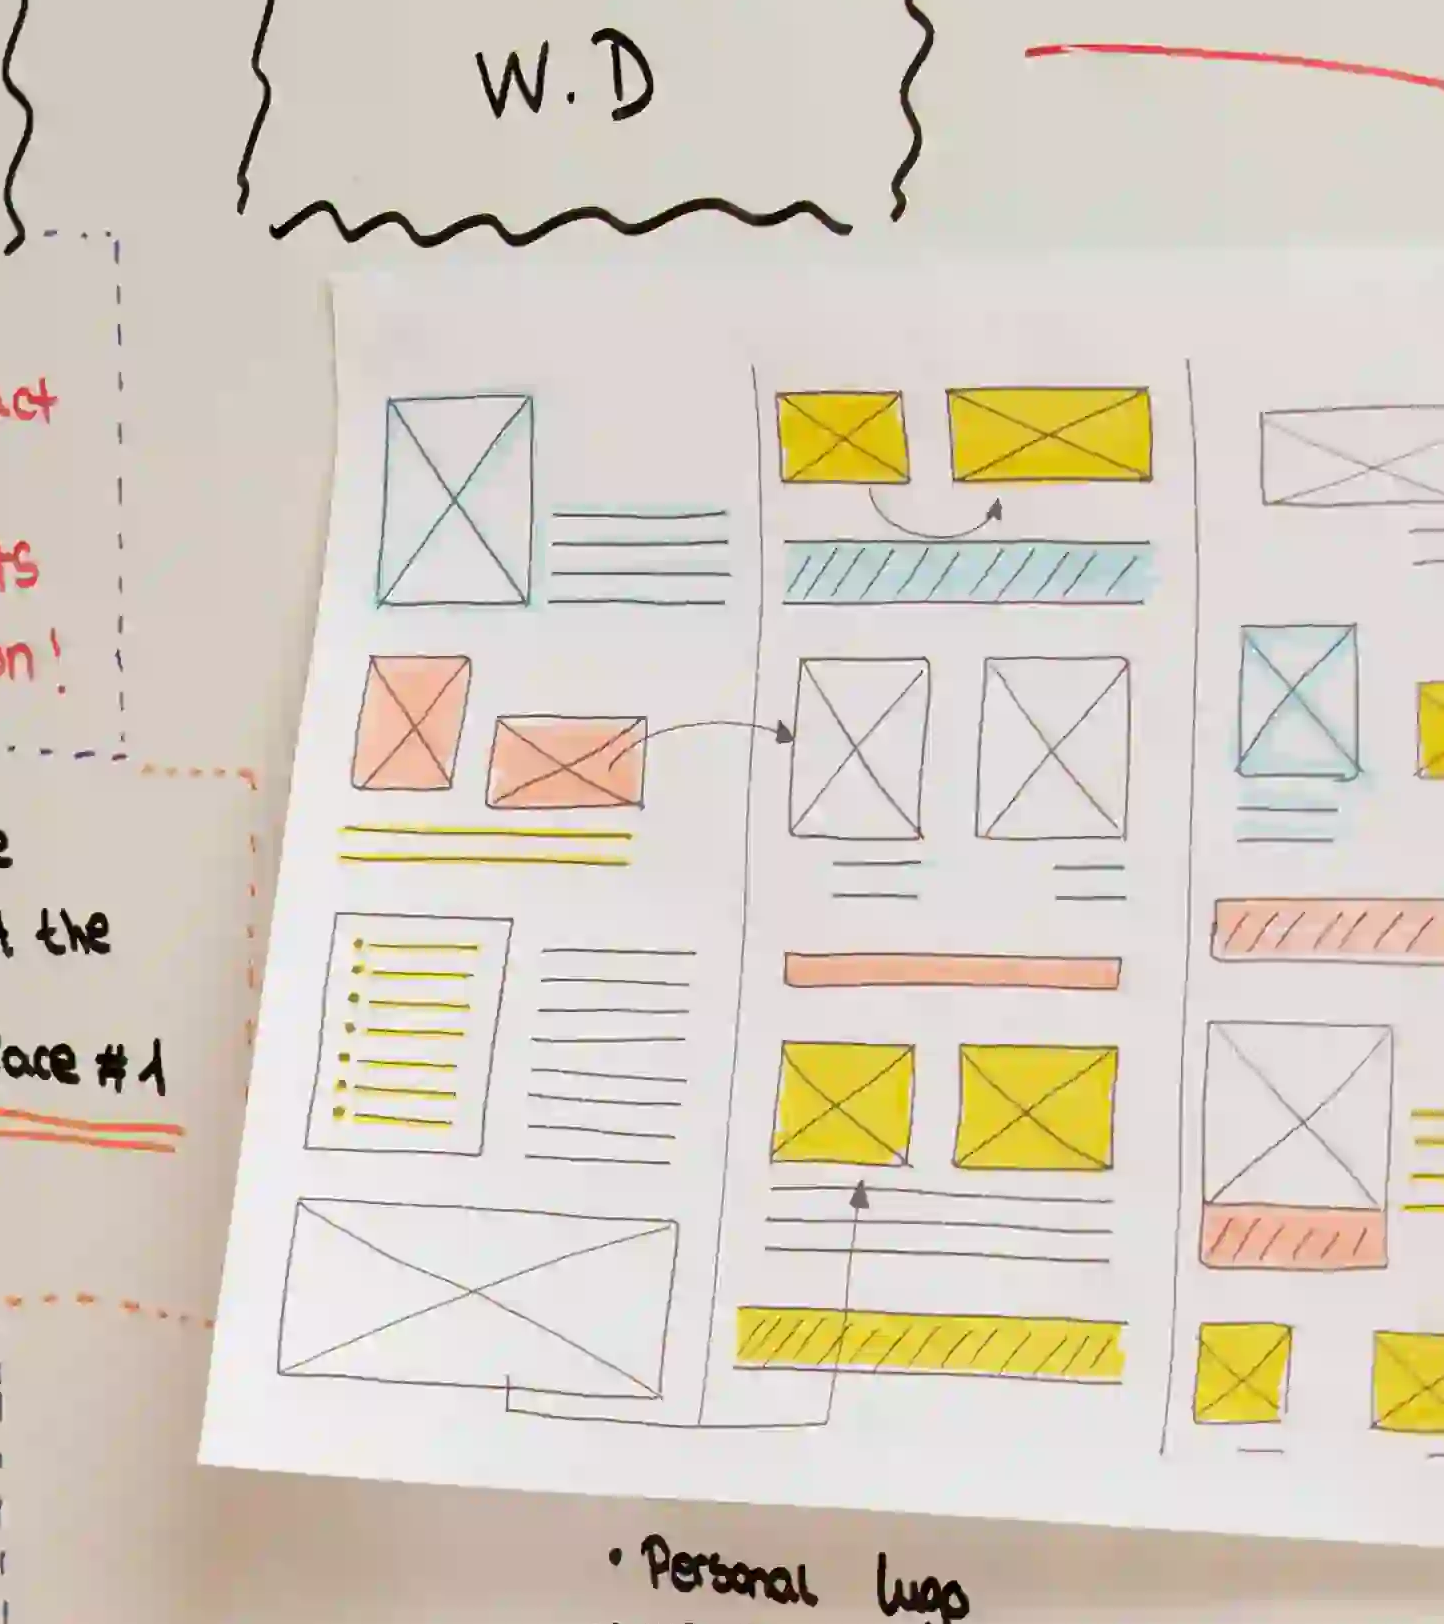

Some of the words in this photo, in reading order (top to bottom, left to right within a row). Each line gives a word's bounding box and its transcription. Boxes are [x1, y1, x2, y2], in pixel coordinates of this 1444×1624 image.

[35, 908, 110, 956] the
[95, 1038, 165, 1096] #1
[641, 1534, 818, 1607] Personal
